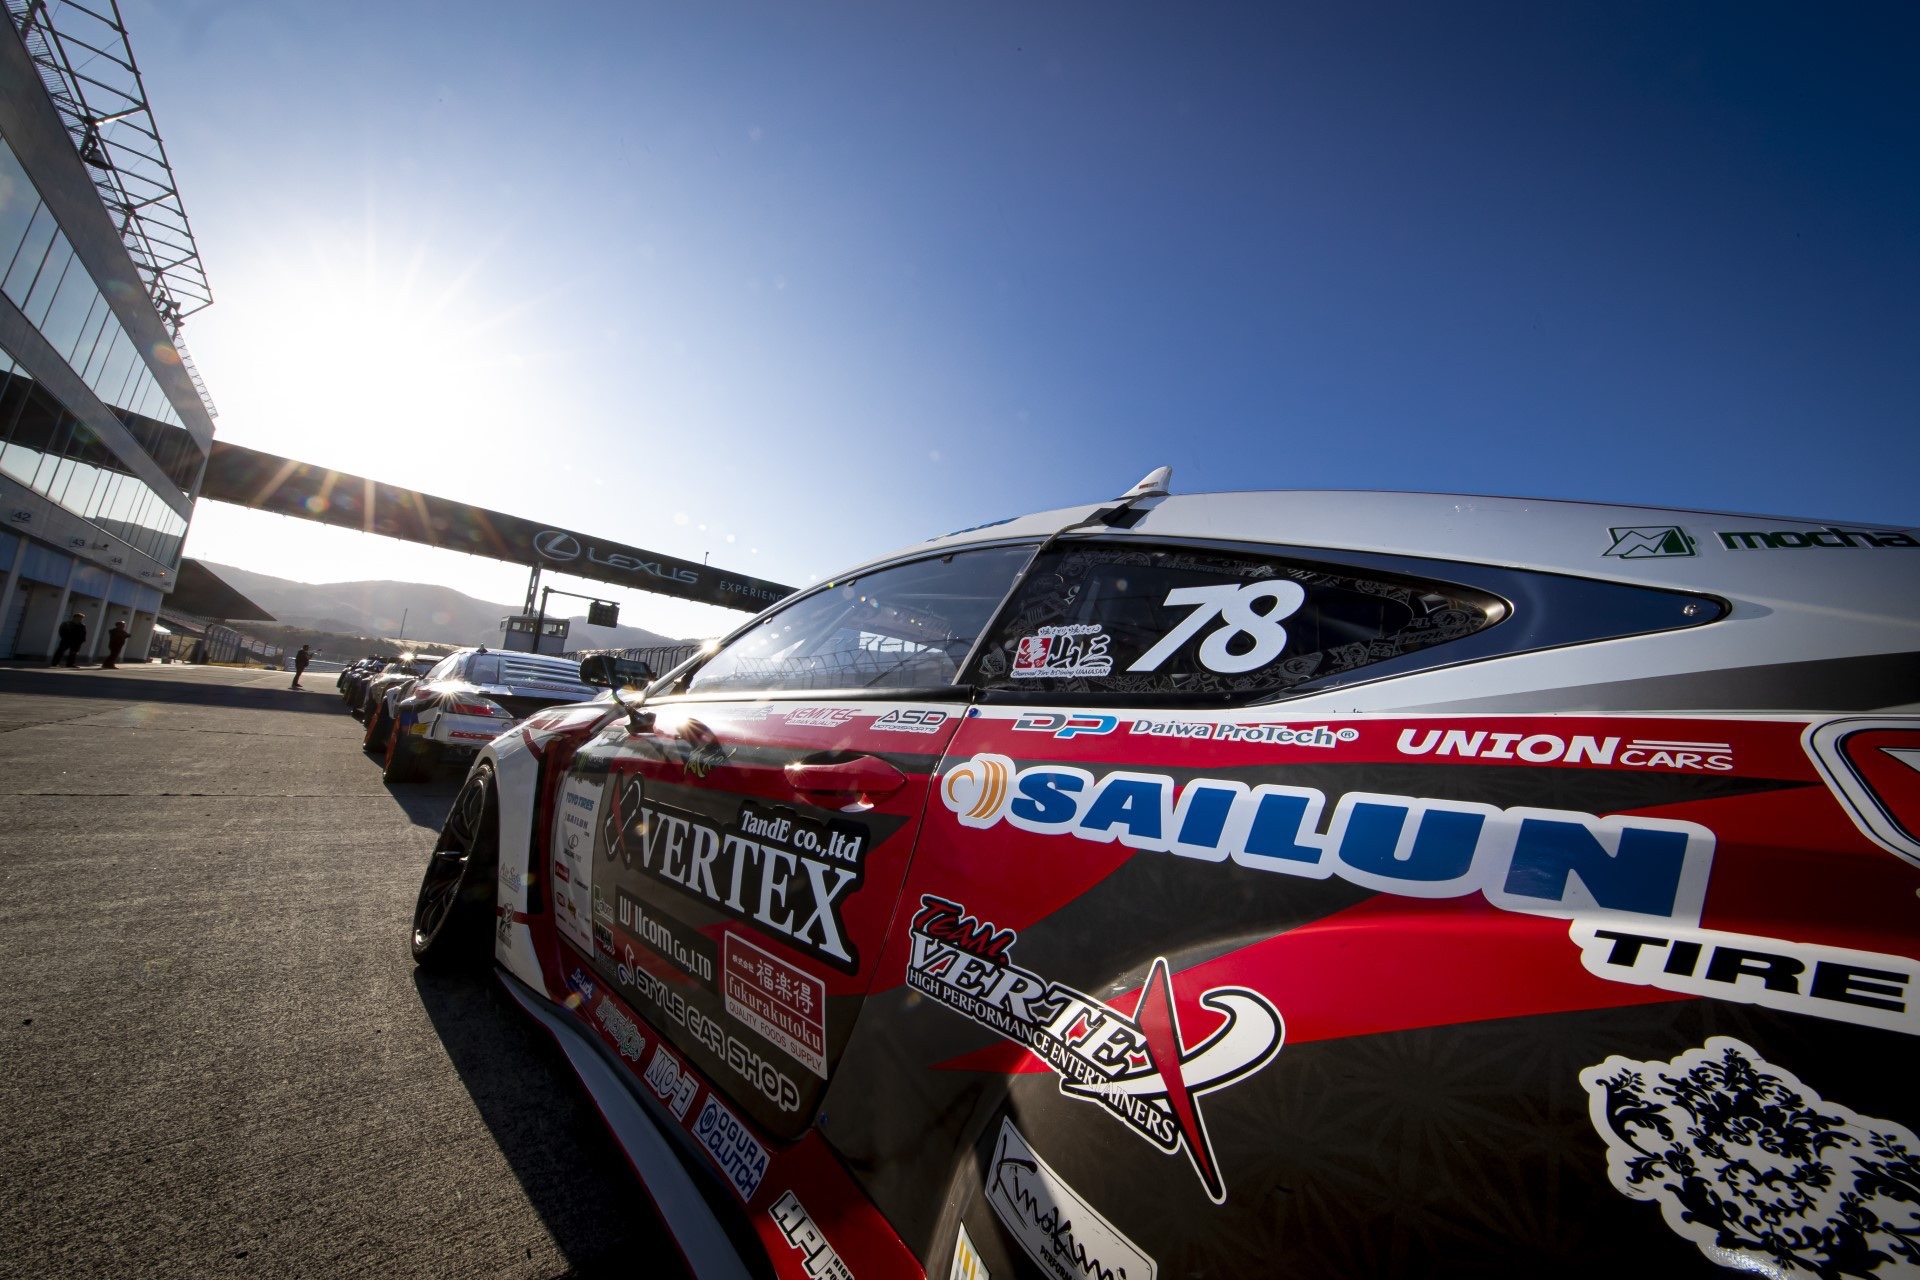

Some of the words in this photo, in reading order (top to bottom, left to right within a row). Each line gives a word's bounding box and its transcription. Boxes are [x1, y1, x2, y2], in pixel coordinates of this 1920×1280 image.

[13, 511, 32, 522] 42
[71, 539, 86, 547] 43
[1717, 526, 1920, 549] mocha
[587, 547, 699, 585] LEXUS
[1126, 579, 1305, 674] 78
[873, 724, 937, 733] MOTORSPORTS
[878, 709, 948, 726] ASD
[1132, 719, 1210, 738] Daiwa
[1396, 728, 1621, 765] UNION
[1620, 750, 1734, 770] CARS
[741, 809, 792, 843] TandE
[1010, 767, 1690, 919] SAILUN
[641, 806, 857, 964] VERTEX
[756, 958, 814, 1014] 福楽得
[1594, 929, 1912, 1014] TIRE
[636, 965, 686, 1027] STYLE
[686, 1004, 726, 1061] CAR
[726, 1035, 801, 1113] SHOP
[728, 976, 822, 1052] fukurakutoku
[729, 1001, 757, 1027] QUALITY
[760, 1022, 787, 1048] FOODS
[790, 1041, 822, 1072] SUPPLY
[909, 970, 940, 996] HIGH
[943, 985, 1051, 1054] PERFORMANCE
[1050, 1042, 1176, 1143] ENTERTAINERS
[707, 1129, 759, 1199] CLUTCH
[718, 1110, 767, 1178] OGURA
